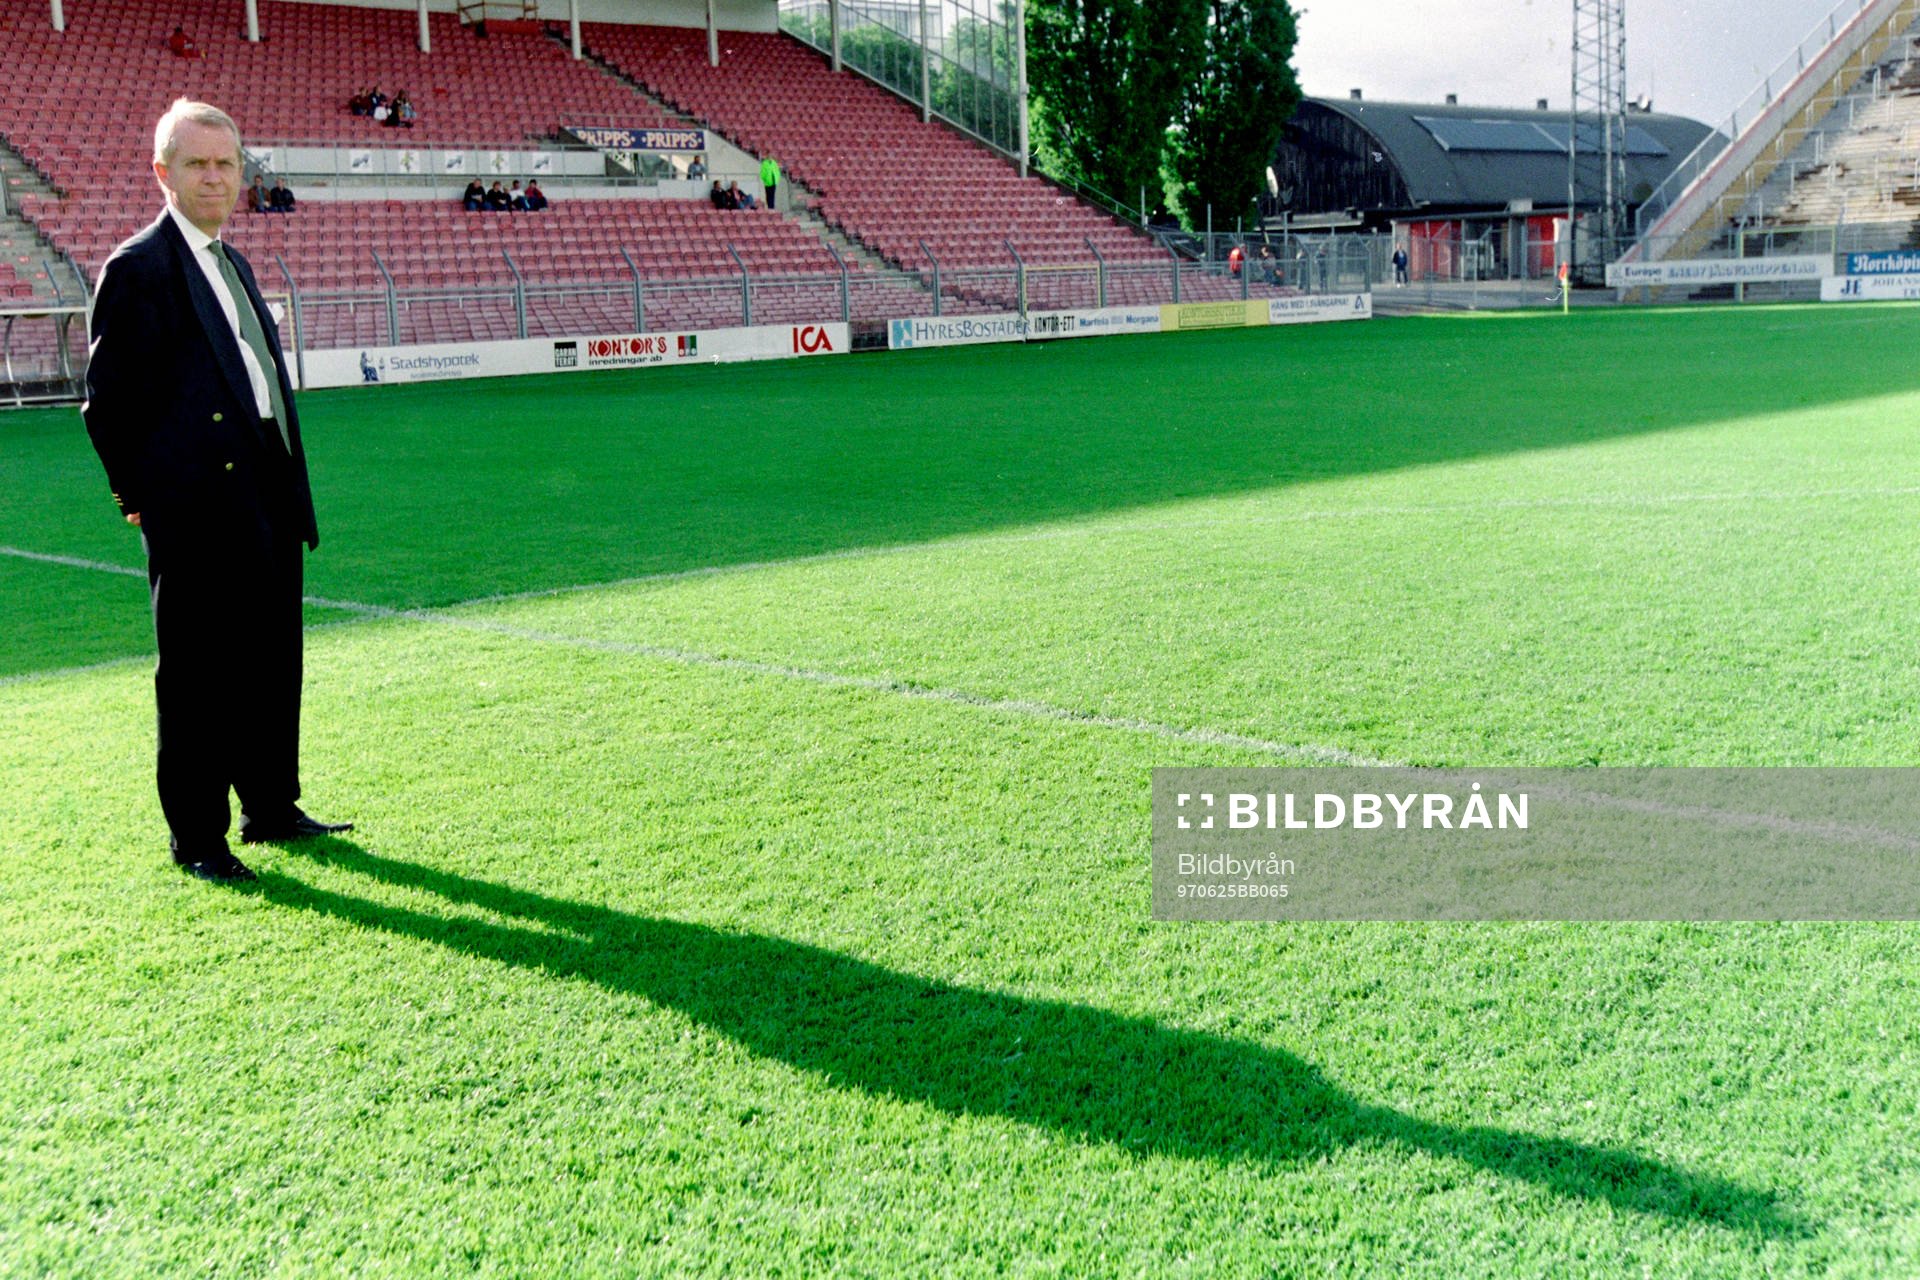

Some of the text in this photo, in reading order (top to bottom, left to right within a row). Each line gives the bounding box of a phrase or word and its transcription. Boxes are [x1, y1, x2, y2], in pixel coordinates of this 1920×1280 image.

[645, 132, 698, 148] PRIPPS
[588, 336, 667, 357] KONTOR'S
[793, 326, 833, 353] ICA
[390, 353, 479, 370] Stadshypotek
[589, 355, 662, 367] inredningar ab
